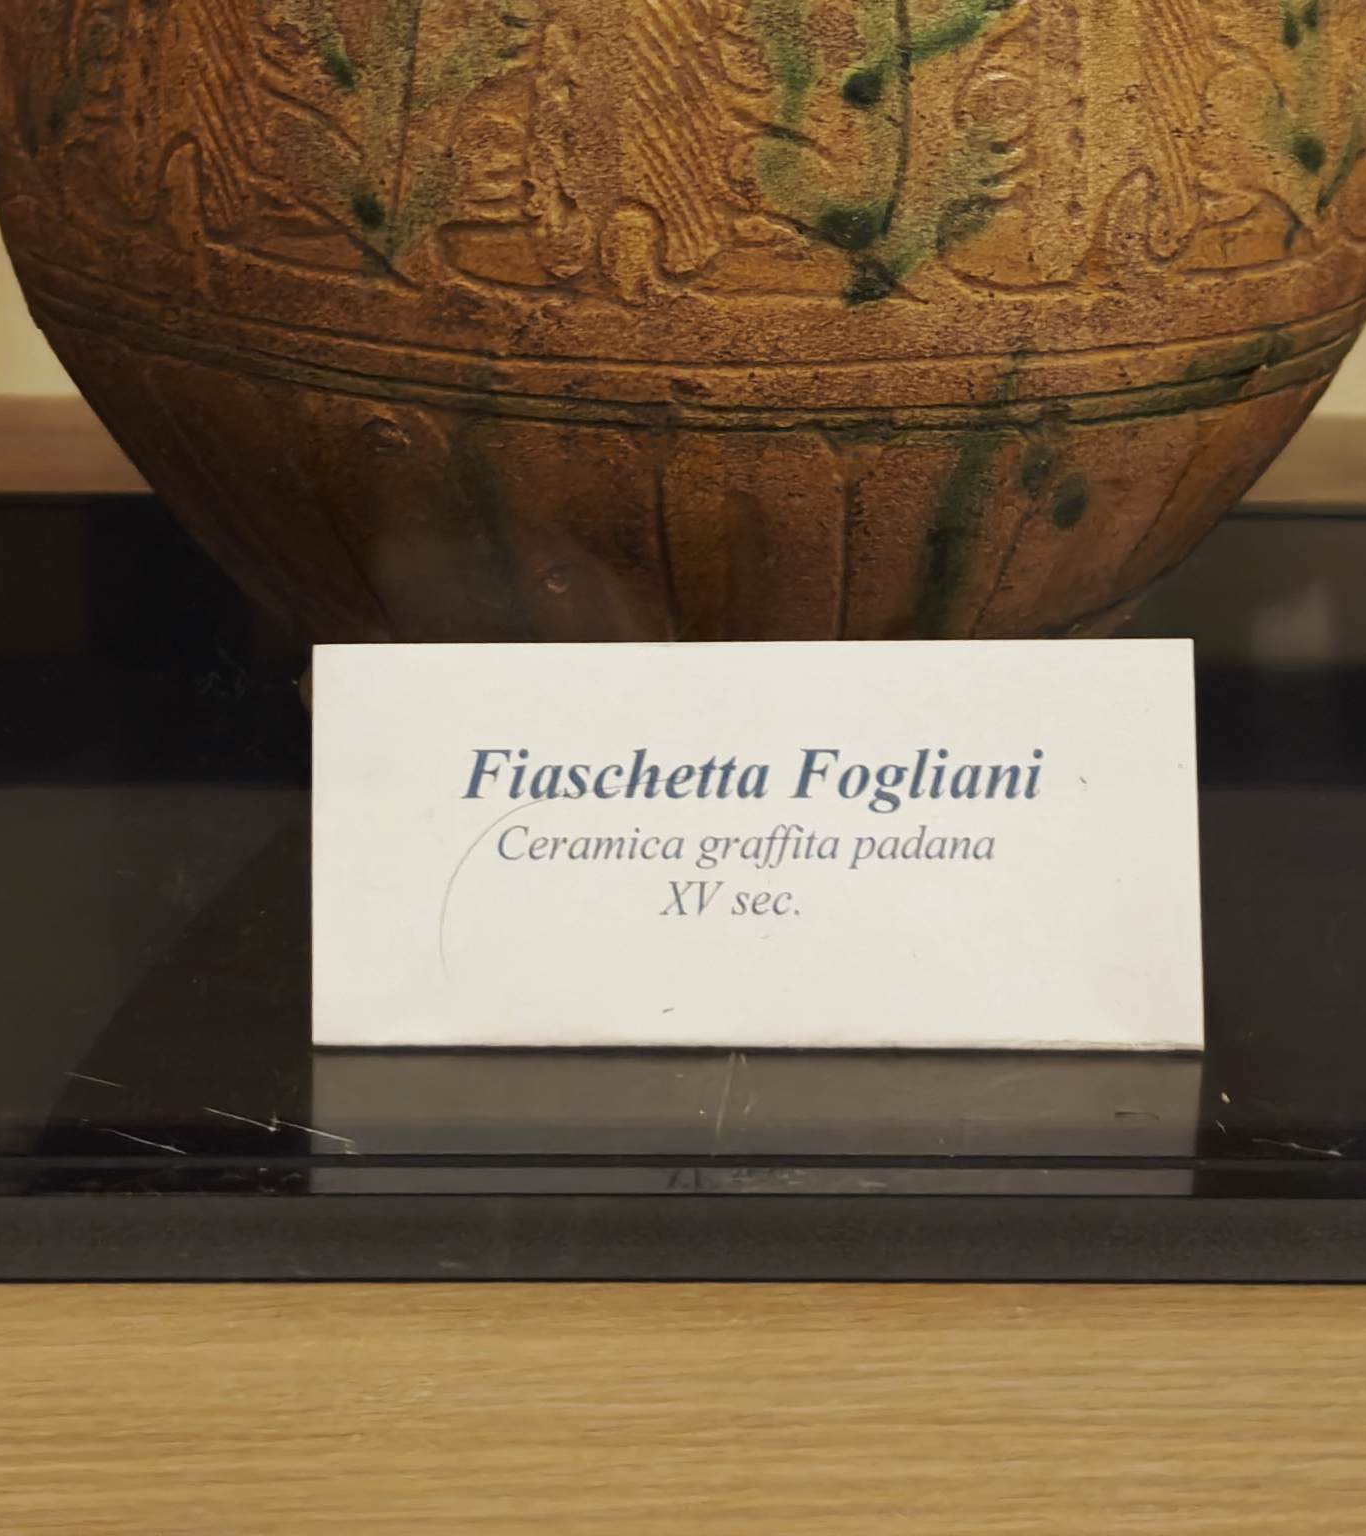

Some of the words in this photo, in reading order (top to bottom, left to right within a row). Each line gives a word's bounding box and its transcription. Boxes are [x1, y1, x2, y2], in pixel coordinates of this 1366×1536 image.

[459, 746, 770, 801] Fiaschetta
[788, 746, 1045, 814] Fogliani
[496, 823, 685, 862] Ceramica
[694, 822, 841, 870] graffita
[847, 823, 997, 870] padana
[658, 879, 725, 917] XV
[730, 890, 801, 917] sec.
